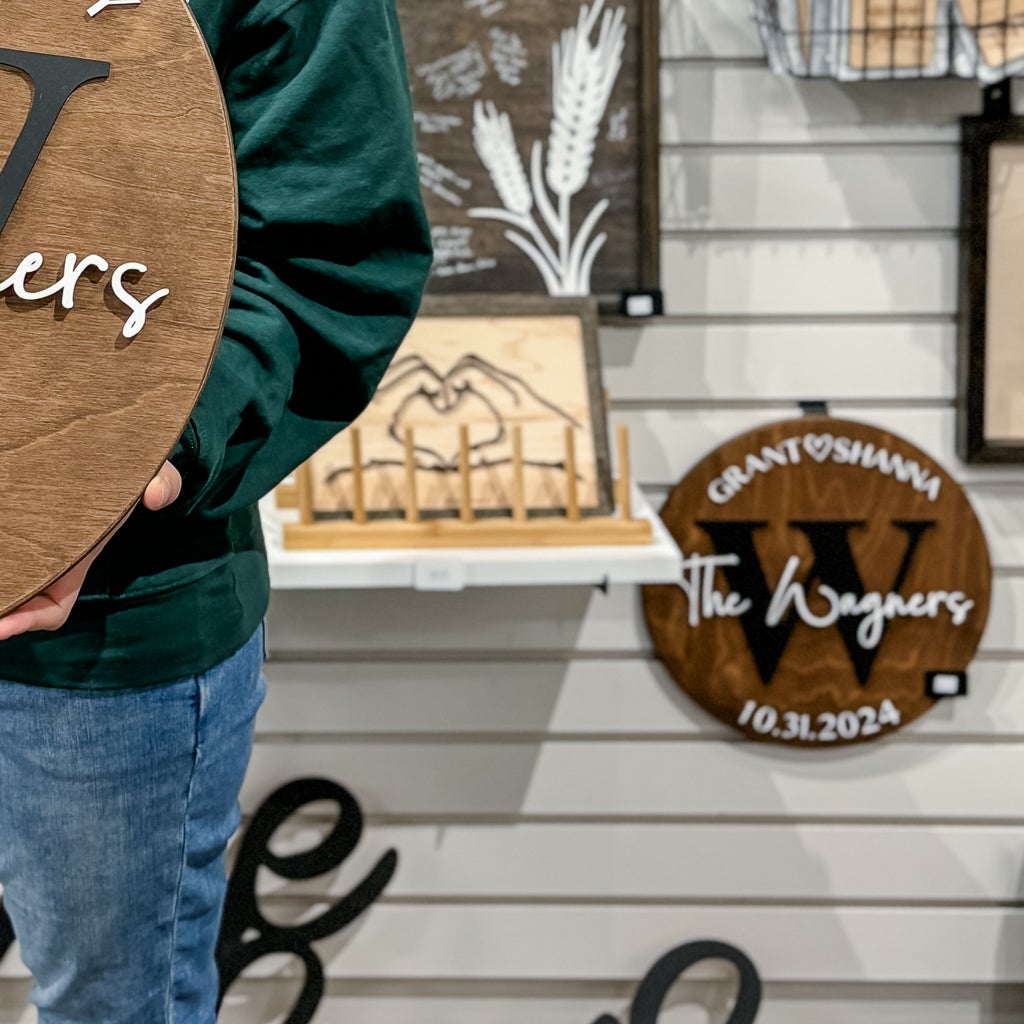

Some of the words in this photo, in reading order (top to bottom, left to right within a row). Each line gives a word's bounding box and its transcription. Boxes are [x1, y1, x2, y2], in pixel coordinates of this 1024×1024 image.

[707, 435, 803, 505] GRANT
[832, 436, 942, 502] SHANNA
[681, 551, 753, 628] The
[764, 555, 975, 650] Wagners
[694, 520, 940, 688] W
[738, 697, 902, 742] 10.31.2024
